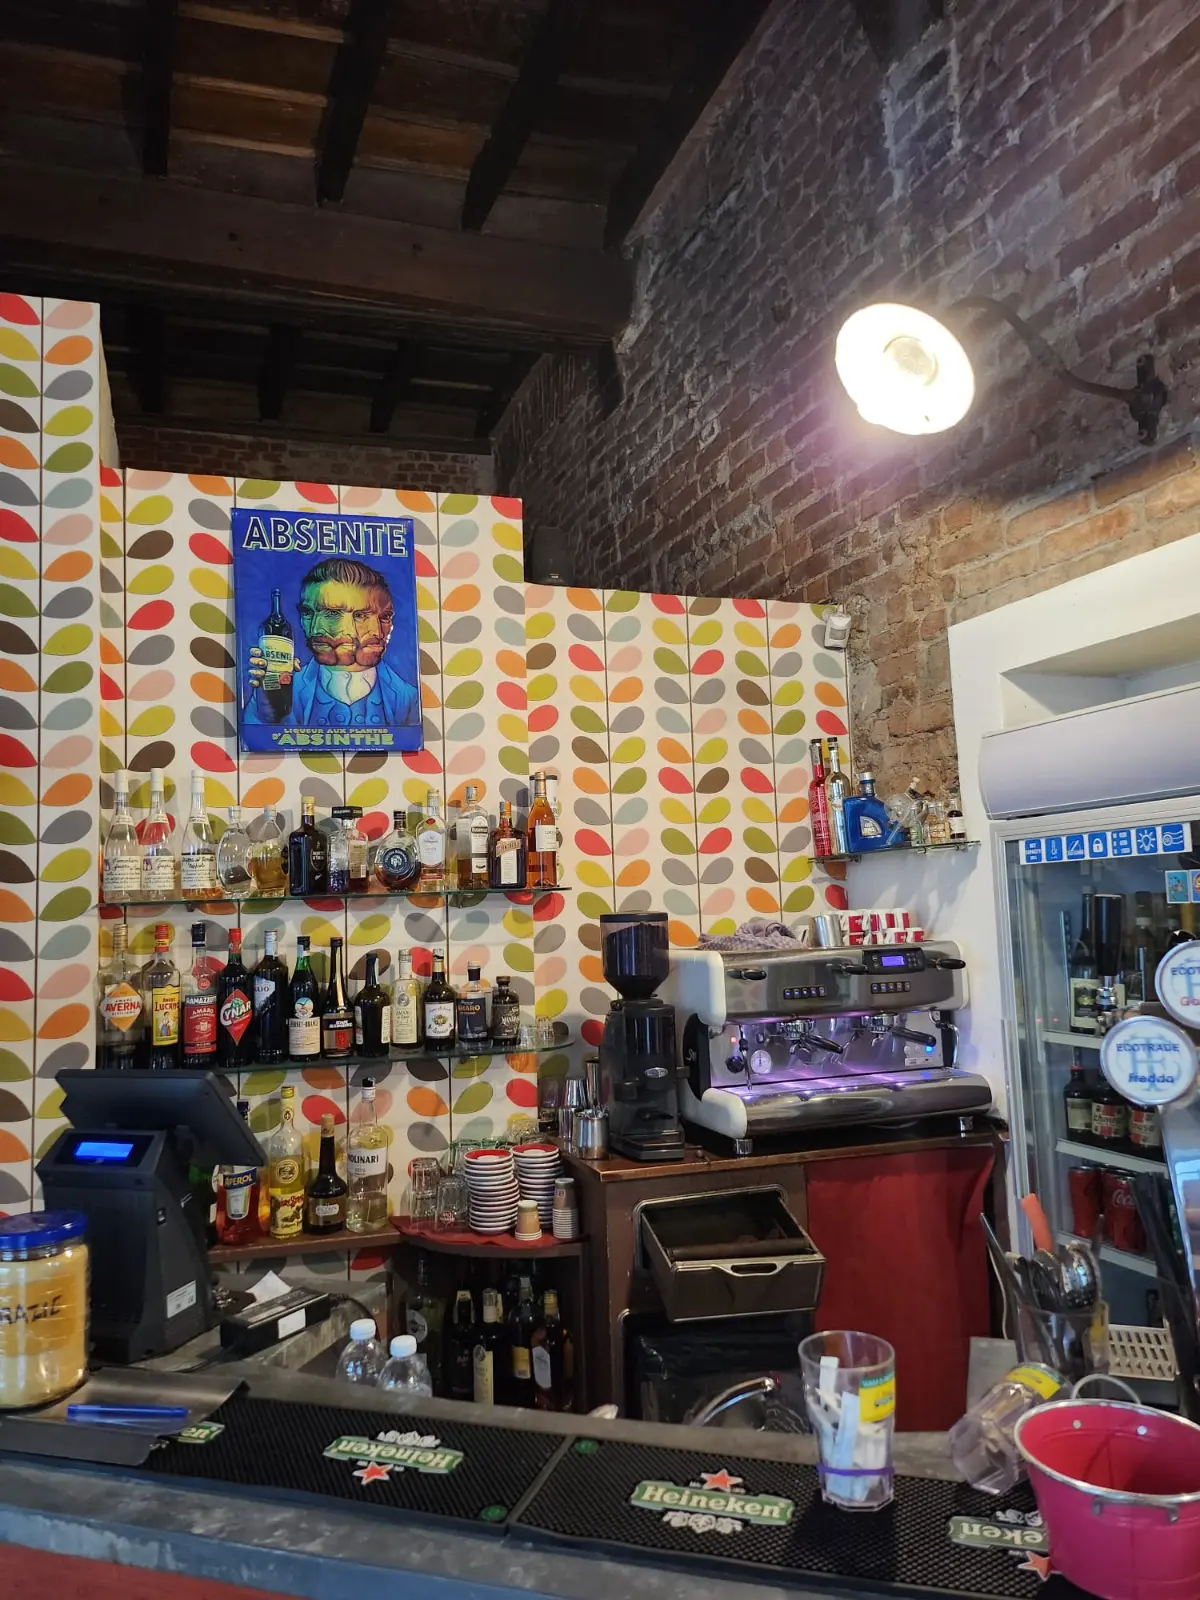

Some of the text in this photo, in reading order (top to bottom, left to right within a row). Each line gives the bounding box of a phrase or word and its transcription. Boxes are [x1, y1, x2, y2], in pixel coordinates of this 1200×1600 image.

[242, 516, 409, 557] ABSENTE
[272, 732, 395, 746] D'ABSINTHE
[105, 1001, 141, 1012] AVERNA
[220, 1000, 252, 1026] CYNAR
[1116, 1043, 1180, 1053] ECOTRADE
[224, 1173, 253, 1187] APEROL
[336, 1440, 455, 1467] Heineken
[640, 1485, 783, 1519] Heineken
[960, 1522, 1044, 1545] eken
